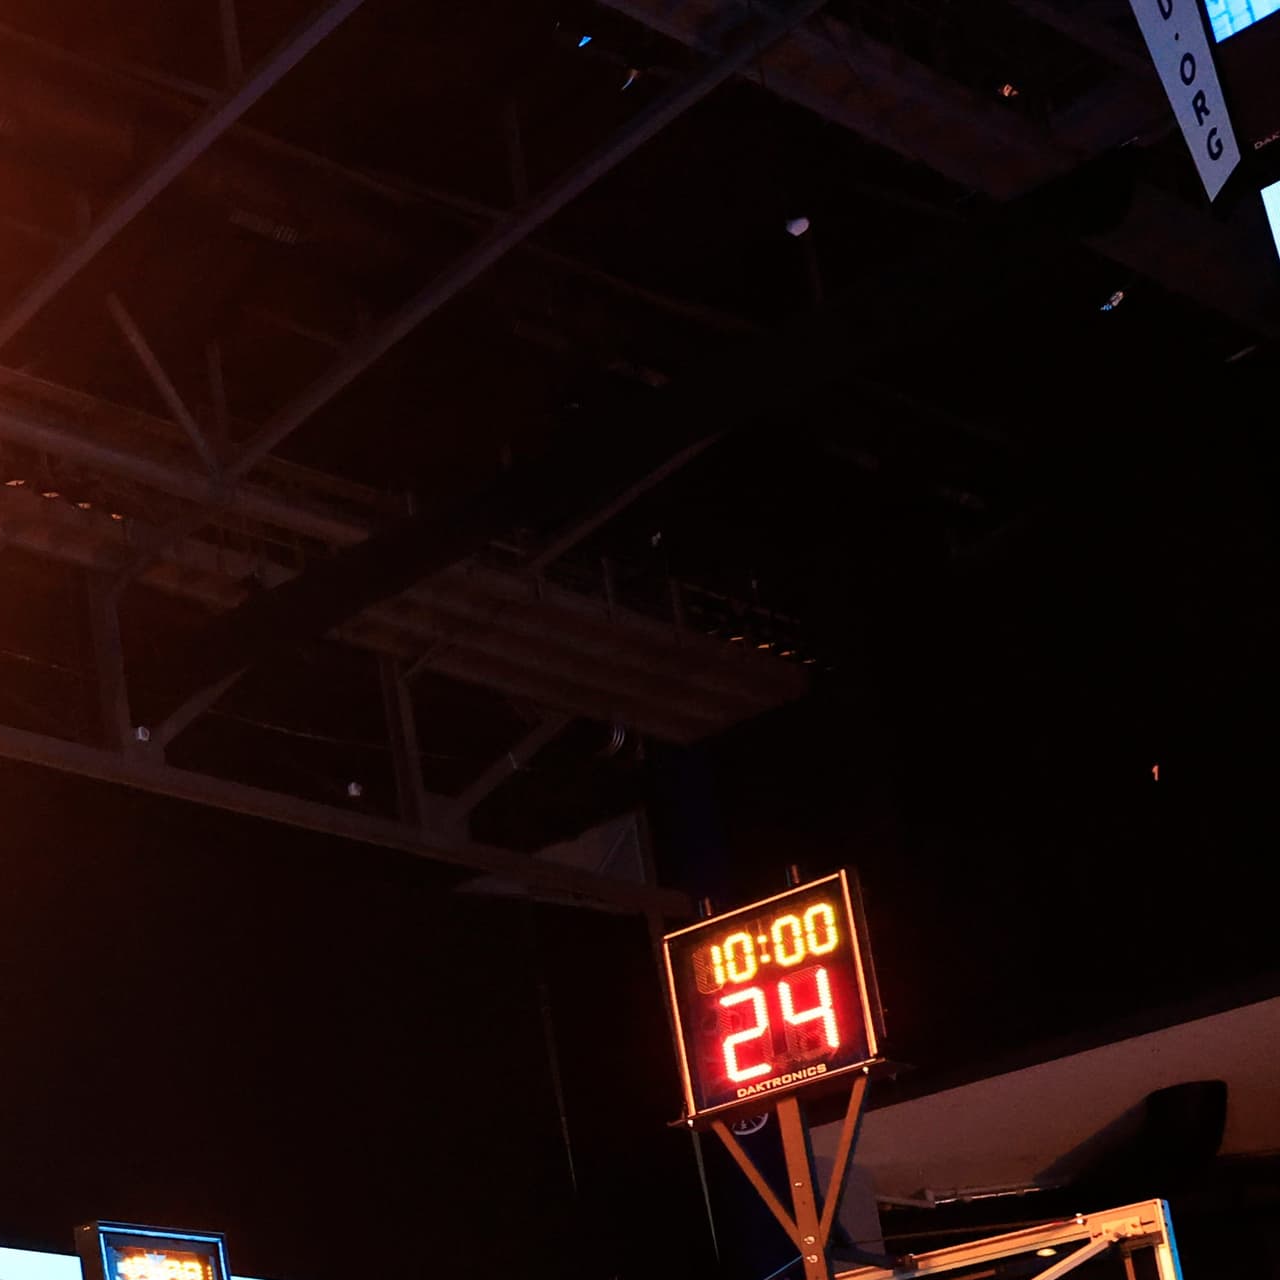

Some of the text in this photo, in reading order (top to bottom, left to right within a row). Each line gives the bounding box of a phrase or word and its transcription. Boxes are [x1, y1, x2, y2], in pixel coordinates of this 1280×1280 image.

[710, 903, 839, 984] 10:00
[719, 968, 840, 1083] 24
[737, 1063, 827, 1098] DAKTRONICS
